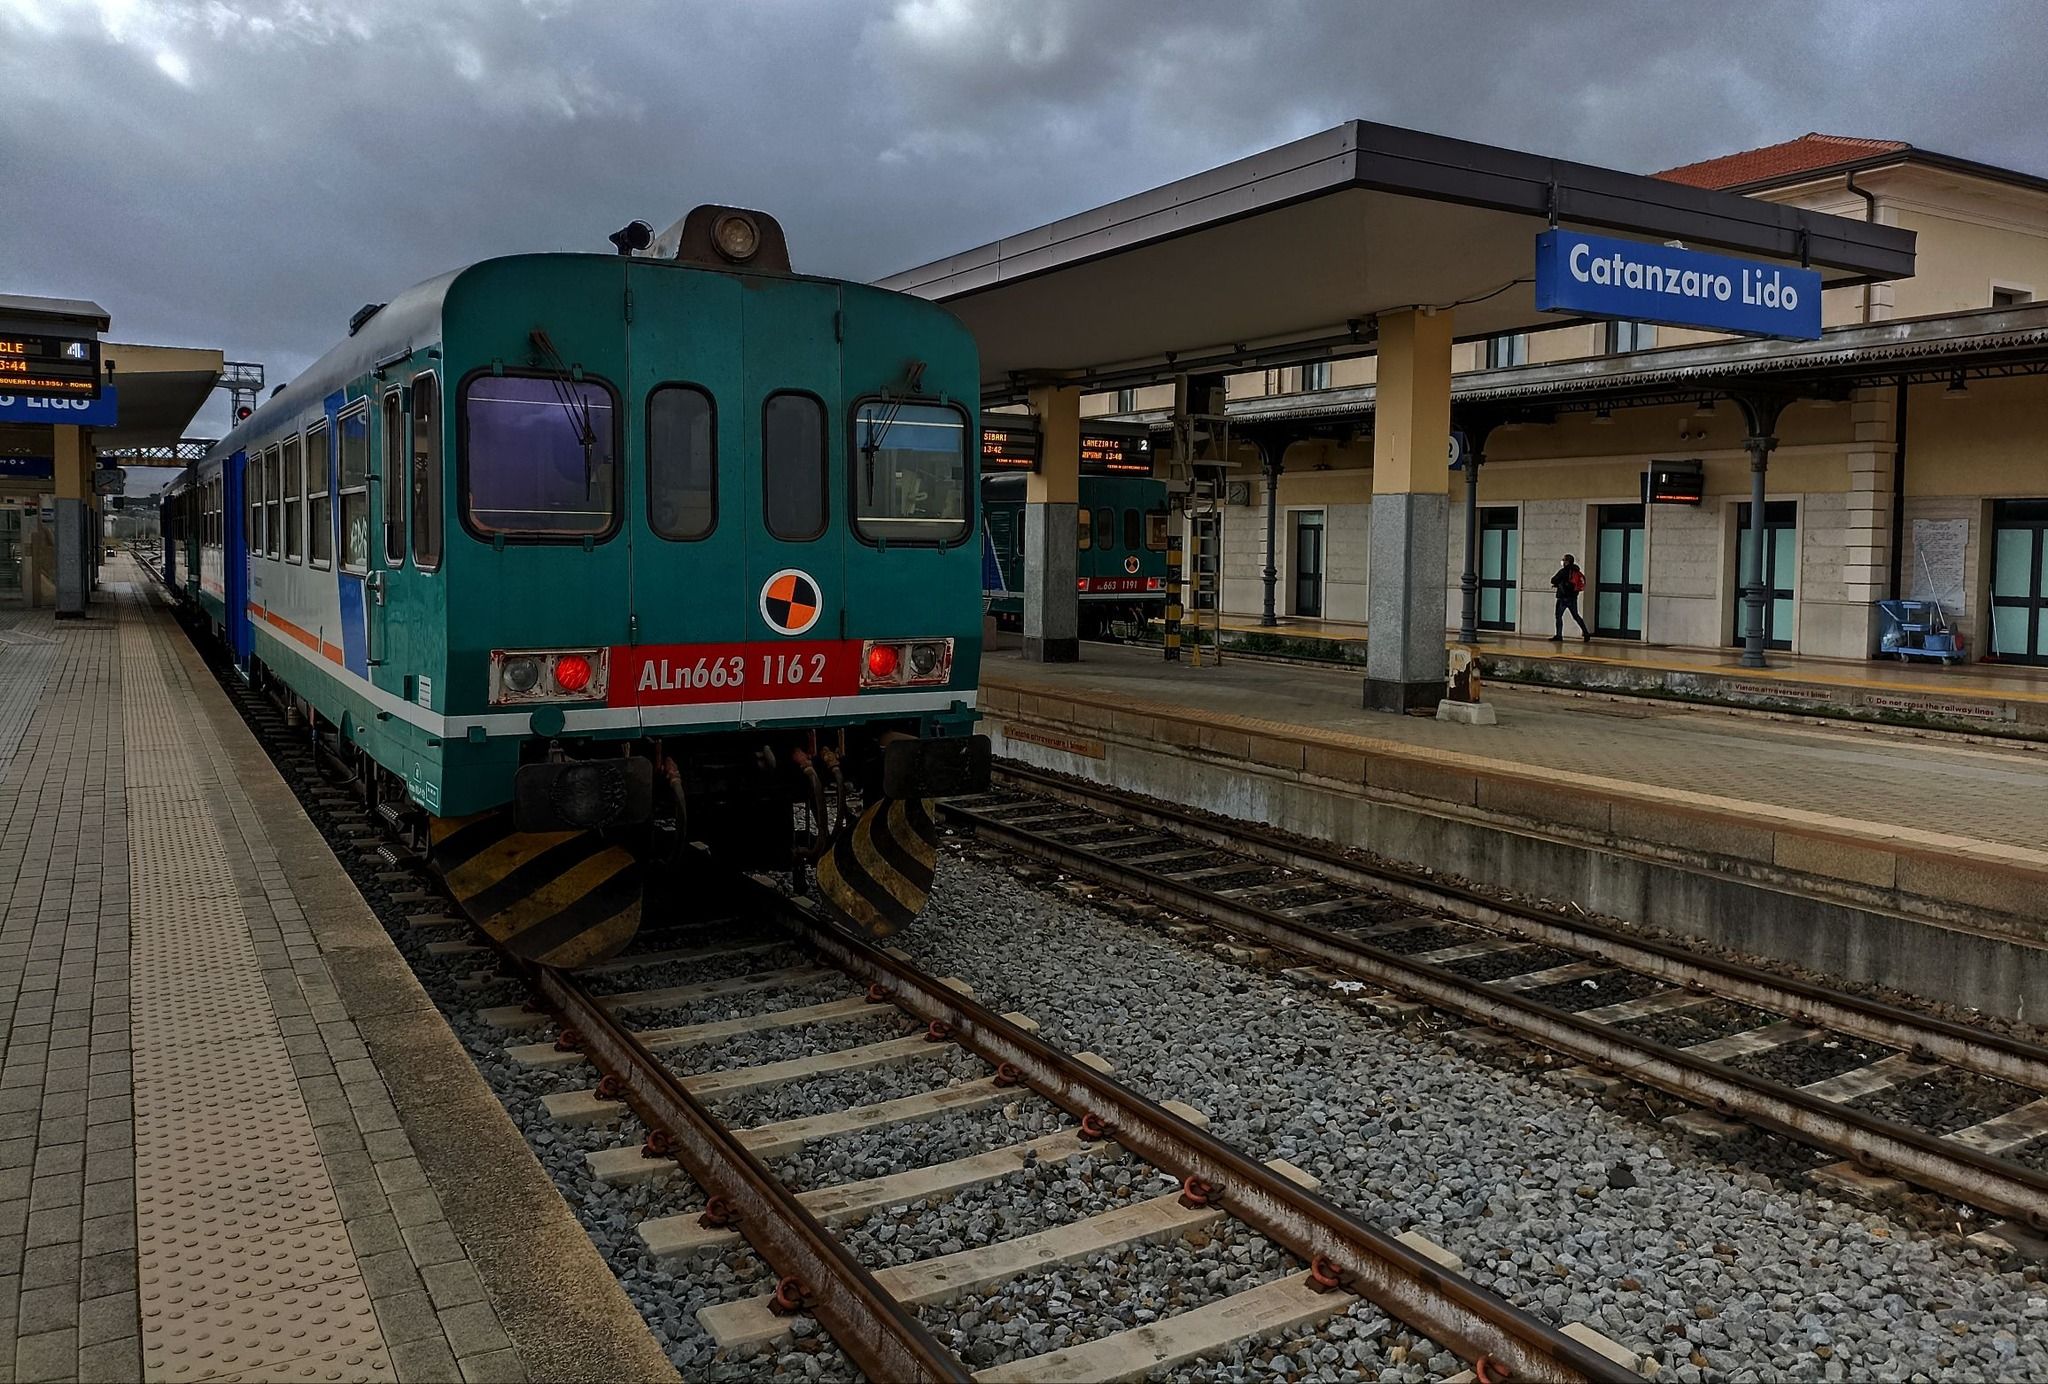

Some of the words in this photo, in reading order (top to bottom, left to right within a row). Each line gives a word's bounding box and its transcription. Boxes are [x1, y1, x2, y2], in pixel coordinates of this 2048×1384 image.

[1569, 243, 1732, 301] Catanzaro
[1742, 269, 1798, 311] Lido
[983, 433, 1007, 442] SIBARI
[983, 446, 1003, 454] 13:42
[1083, 440, 1109, 448] LAMEZIA
[1140, 440, 1148, 451] 2
[1662, 473, 1666, 483] 1
[1122, 580, 1137, 590] 1191
[638, 656, 744, 691] ALn663
[1941, 704, 1972, 714] railway
[1975, 707, 1994, 715] lines
